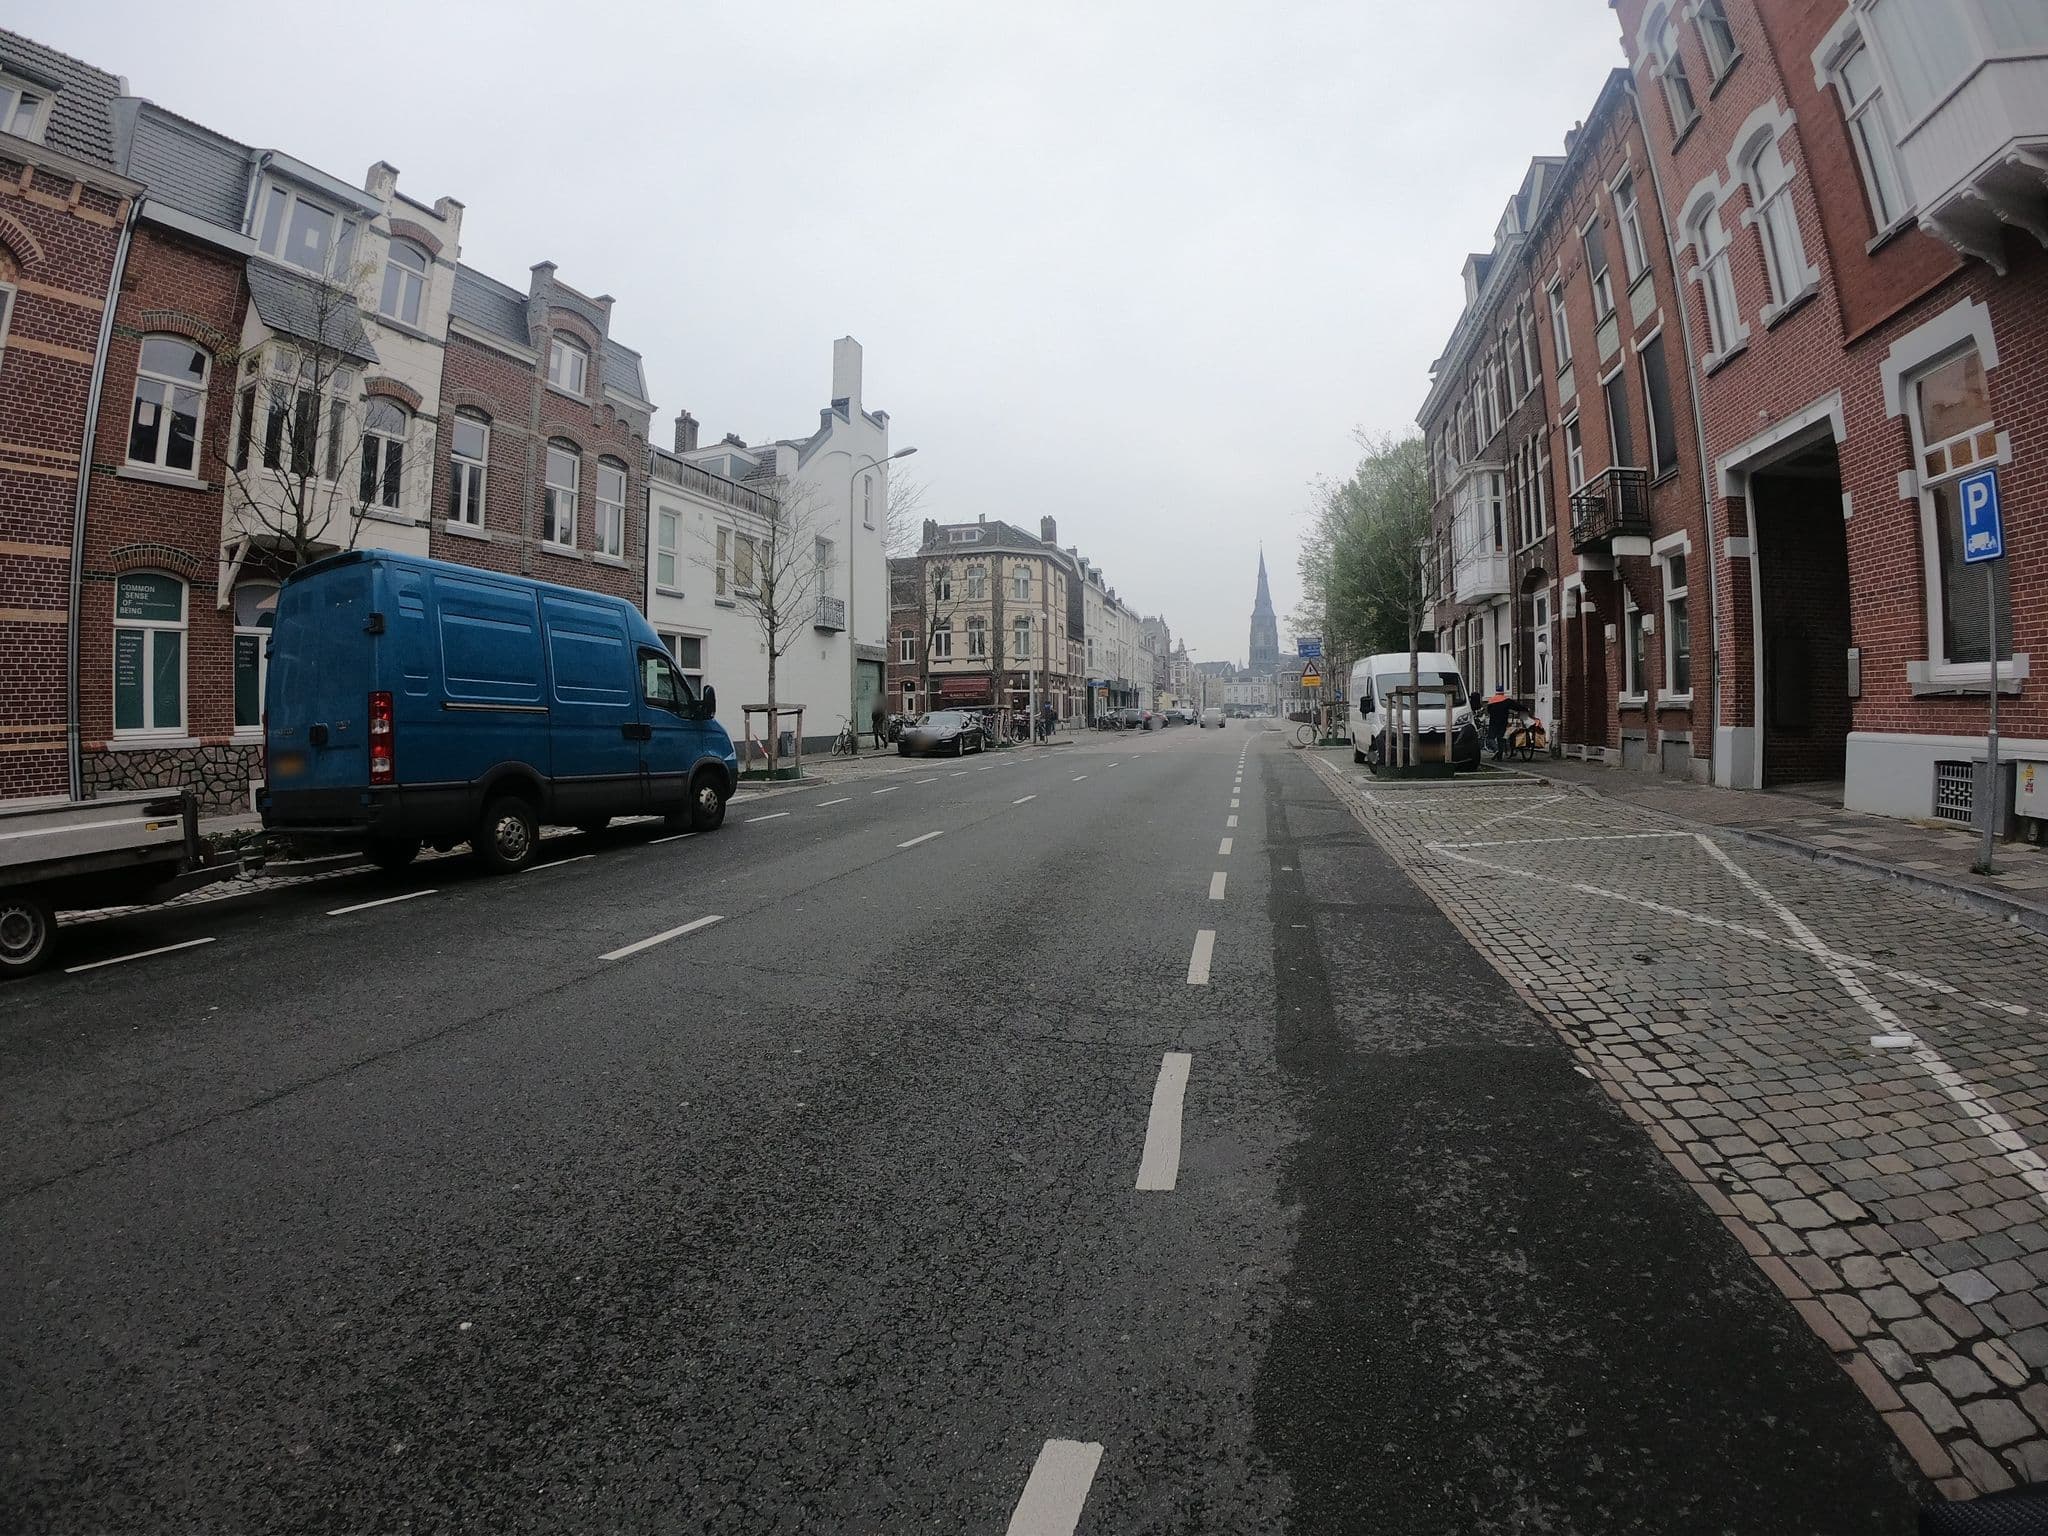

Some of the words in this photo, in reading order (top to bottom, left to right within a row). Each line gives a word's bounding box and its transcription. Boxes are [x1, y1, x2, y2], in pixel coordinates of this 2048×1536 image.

[1967, 482, 1988, 526] P
[120, 583, 156, 593] COMMON
[125, 592, 150, 600] SENSE
[119, 606, 143, 615] BEING
